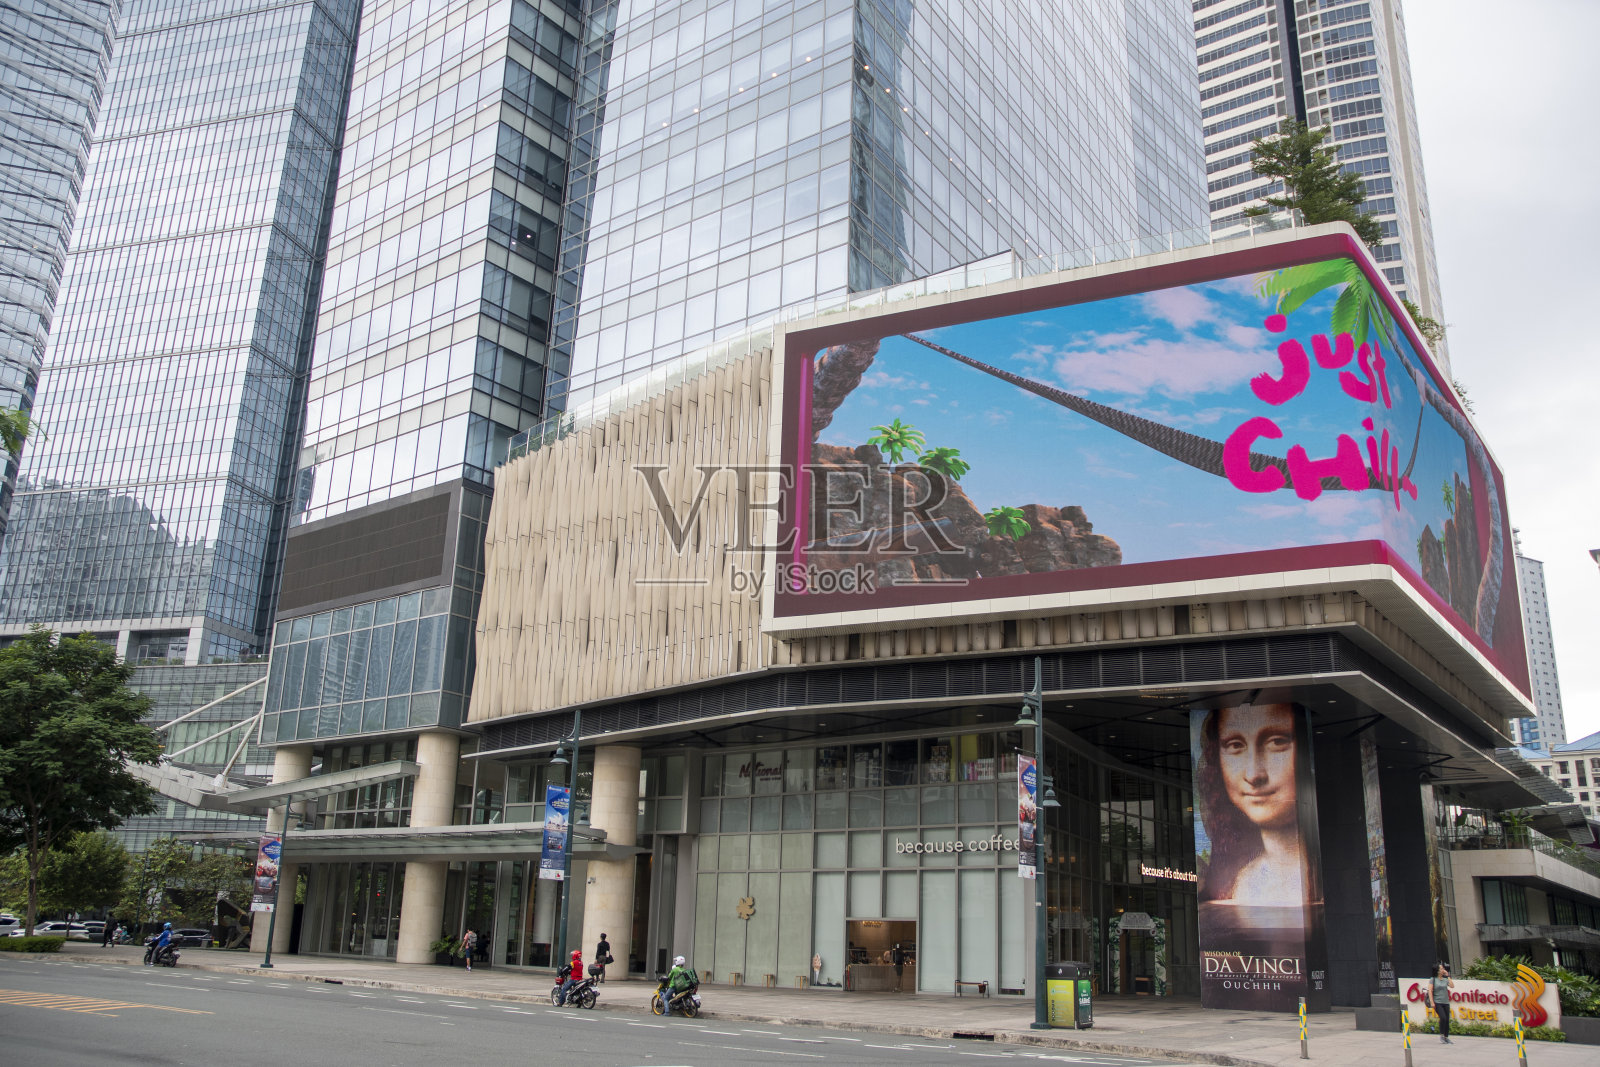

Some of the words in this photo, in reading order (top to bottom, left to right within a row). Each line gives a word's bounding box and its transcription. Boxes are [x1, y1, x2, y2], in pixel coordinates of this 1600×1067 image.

[895, 837, 964, 854] because
[1141, 862, 1164, 878] because
[1164, 866, 1173, 879] it's
[1173, 868, 1189, 881] about
[1205, 957, 1234, 973] DA
[1238, 956, 1302, 975] VINCI
[1223, 980, 1281, 991] OUCHHH
[1458, 1006, 1499, 1022] Street
